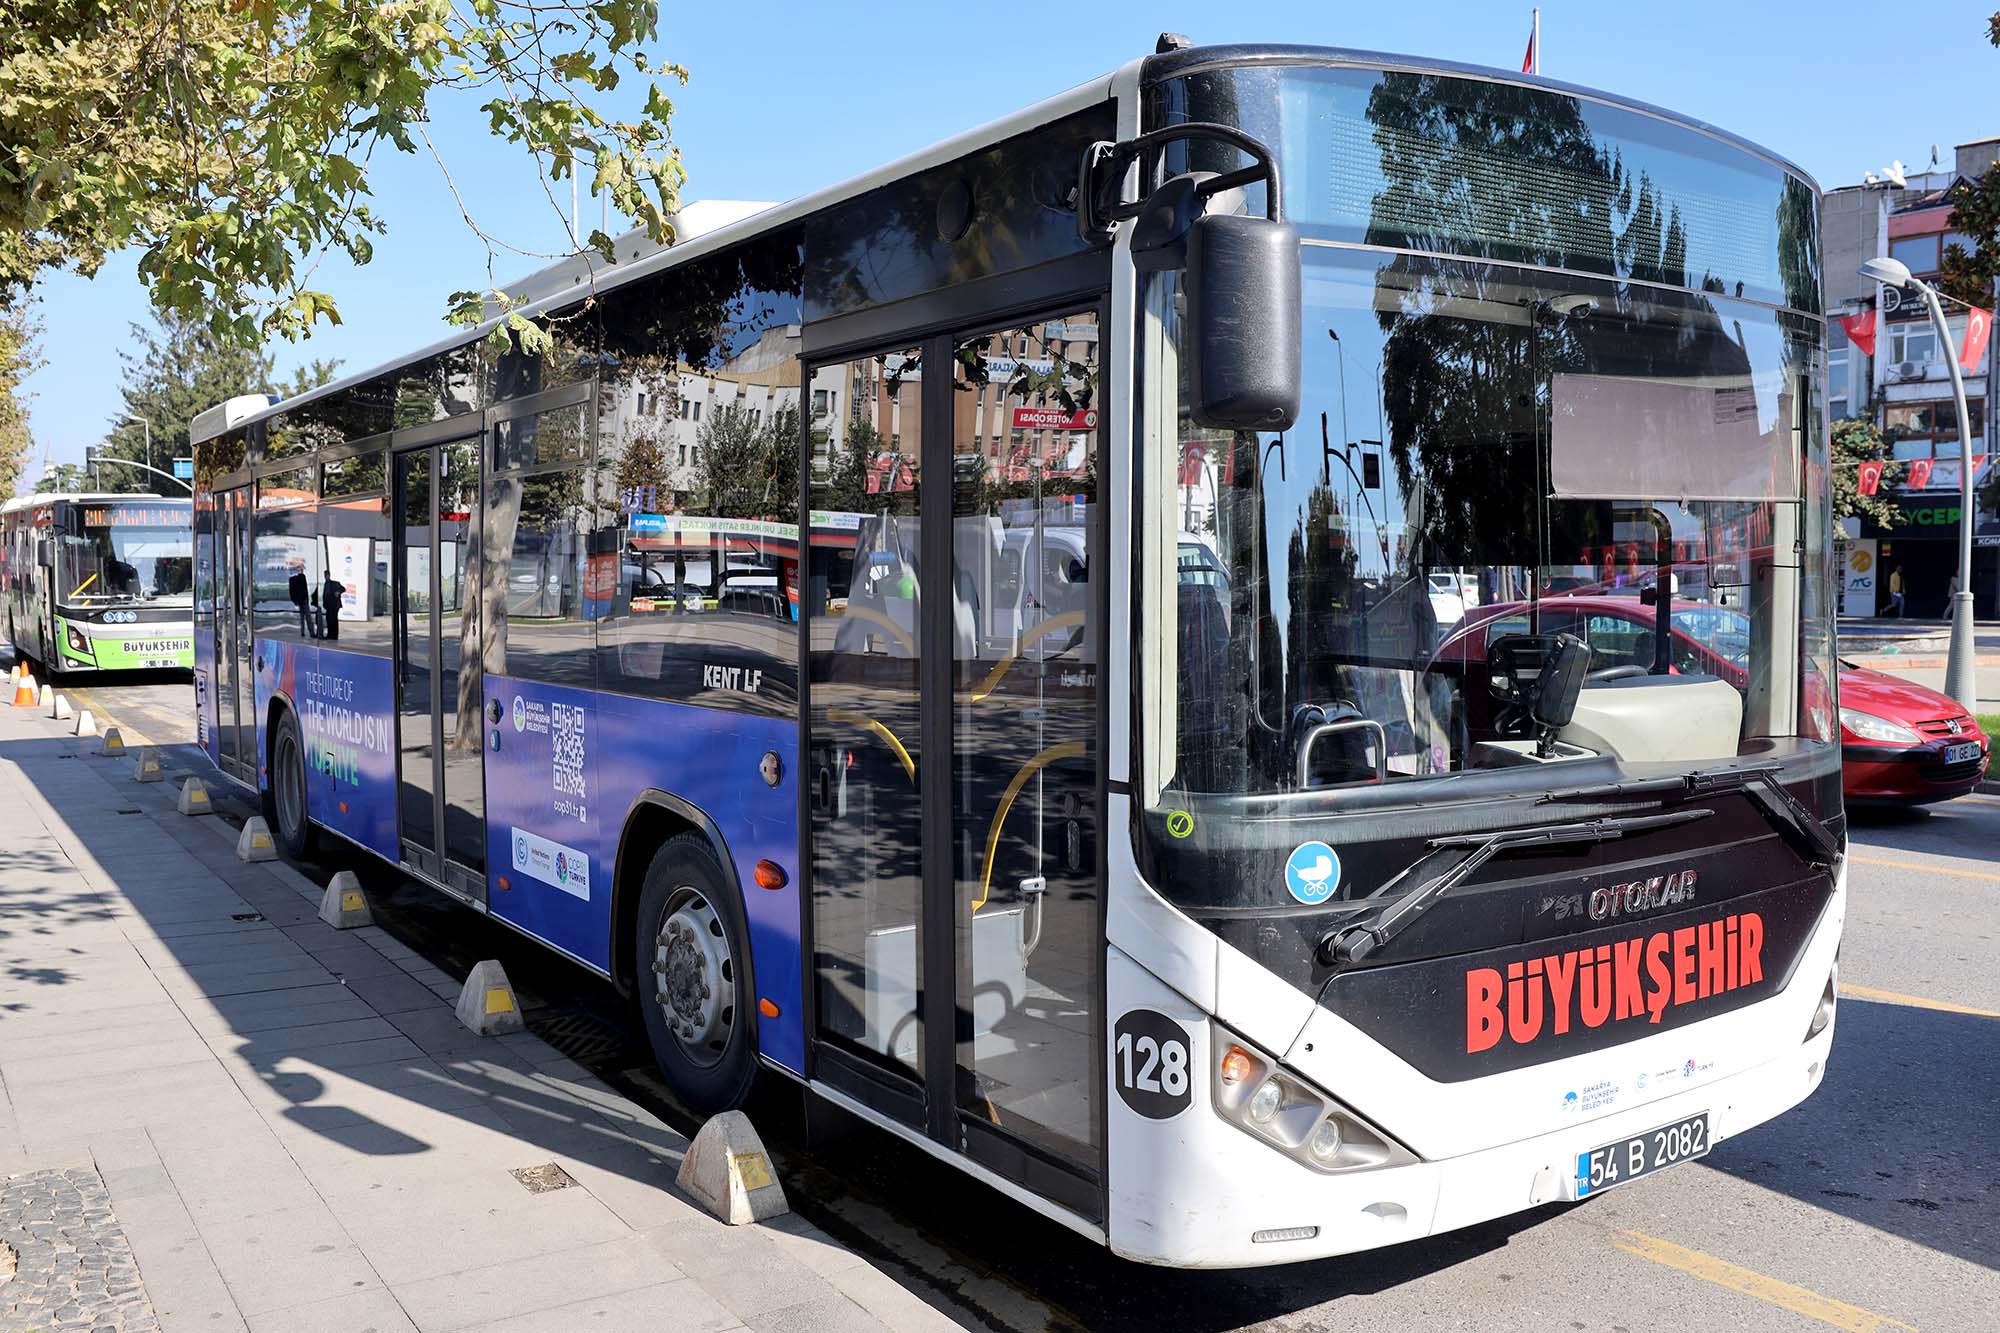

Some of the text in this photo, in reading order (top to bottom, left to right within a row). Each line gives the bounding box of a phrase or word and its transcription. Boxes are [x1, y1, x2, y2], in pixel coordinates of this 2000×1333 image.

[306, 672, 353, 702] THE FUTURE OF
[703, 664, 762, 693] KENT LF
[307, 699, 388, 753] THE WORLD IS IN
[553, 801, 579, 817] cop31.tr
[1589, 869, 1698, 921] OTOKAR
[1466, 912, 1764, 1054] BÜYÜKŞEHİR
[1117, 1032, 1189, 1097] 128
[1583, 1081, 1611, 1095] SAKARYA
[1578, 1118, 1704, 1189] TR 54 B 2082
